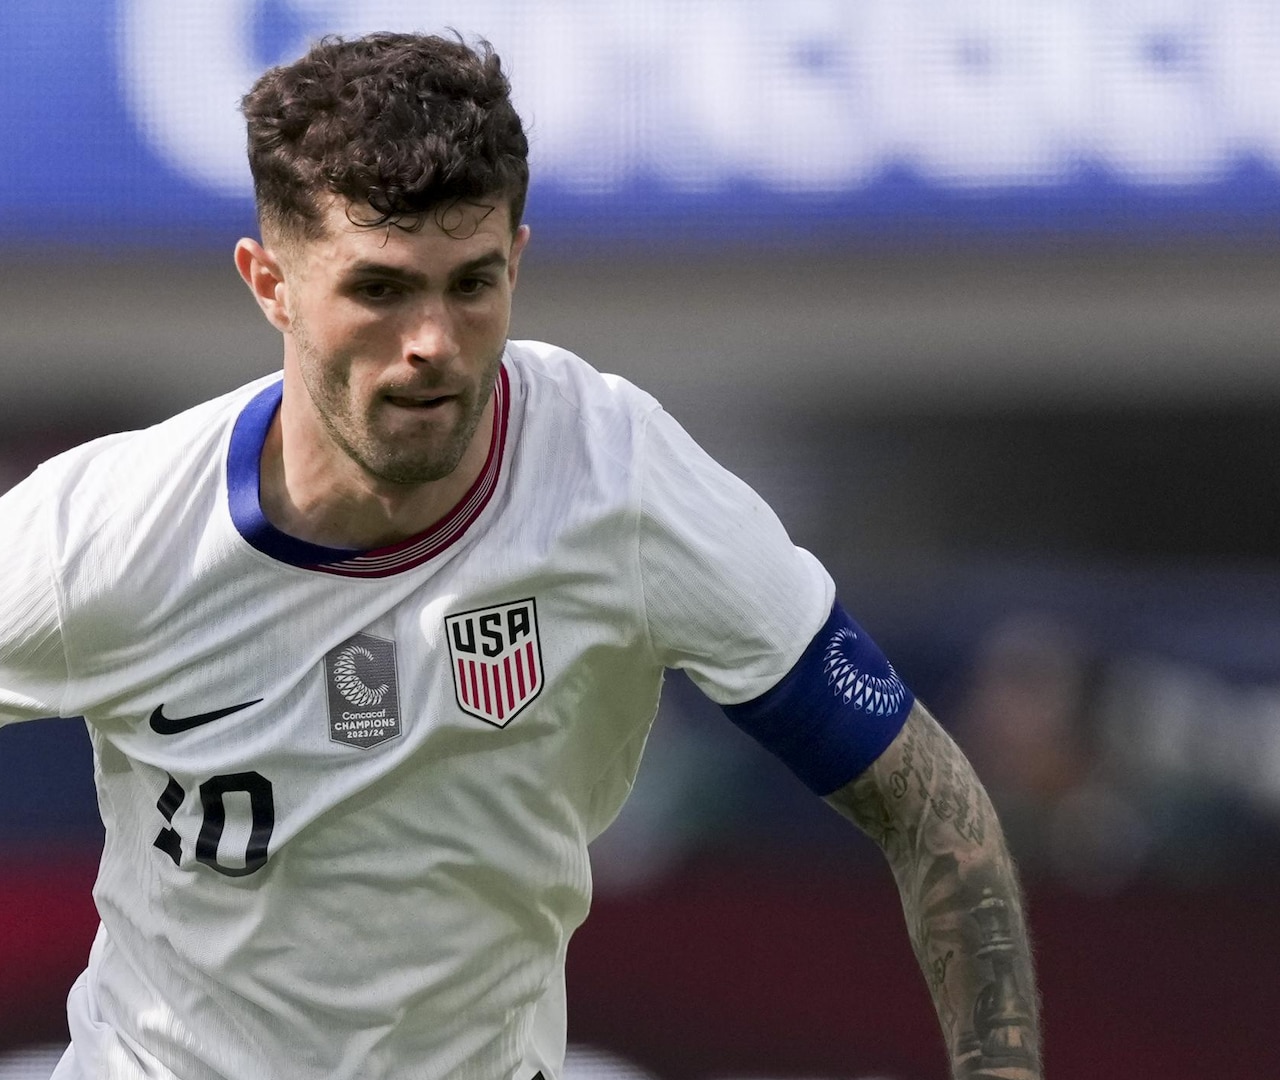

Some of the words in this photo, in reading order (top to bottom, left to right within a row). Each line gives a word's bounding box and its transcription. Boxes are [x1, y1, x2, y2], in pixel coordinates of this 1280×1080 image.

[452, 607, 530, 657] USA
[342, 709, 386, 720] Concacaf
[334, 718, 395, 730] CHAMPIONS
[347, 729, 384, 738] 2023/24
[153, 771, 275, 877] 10
